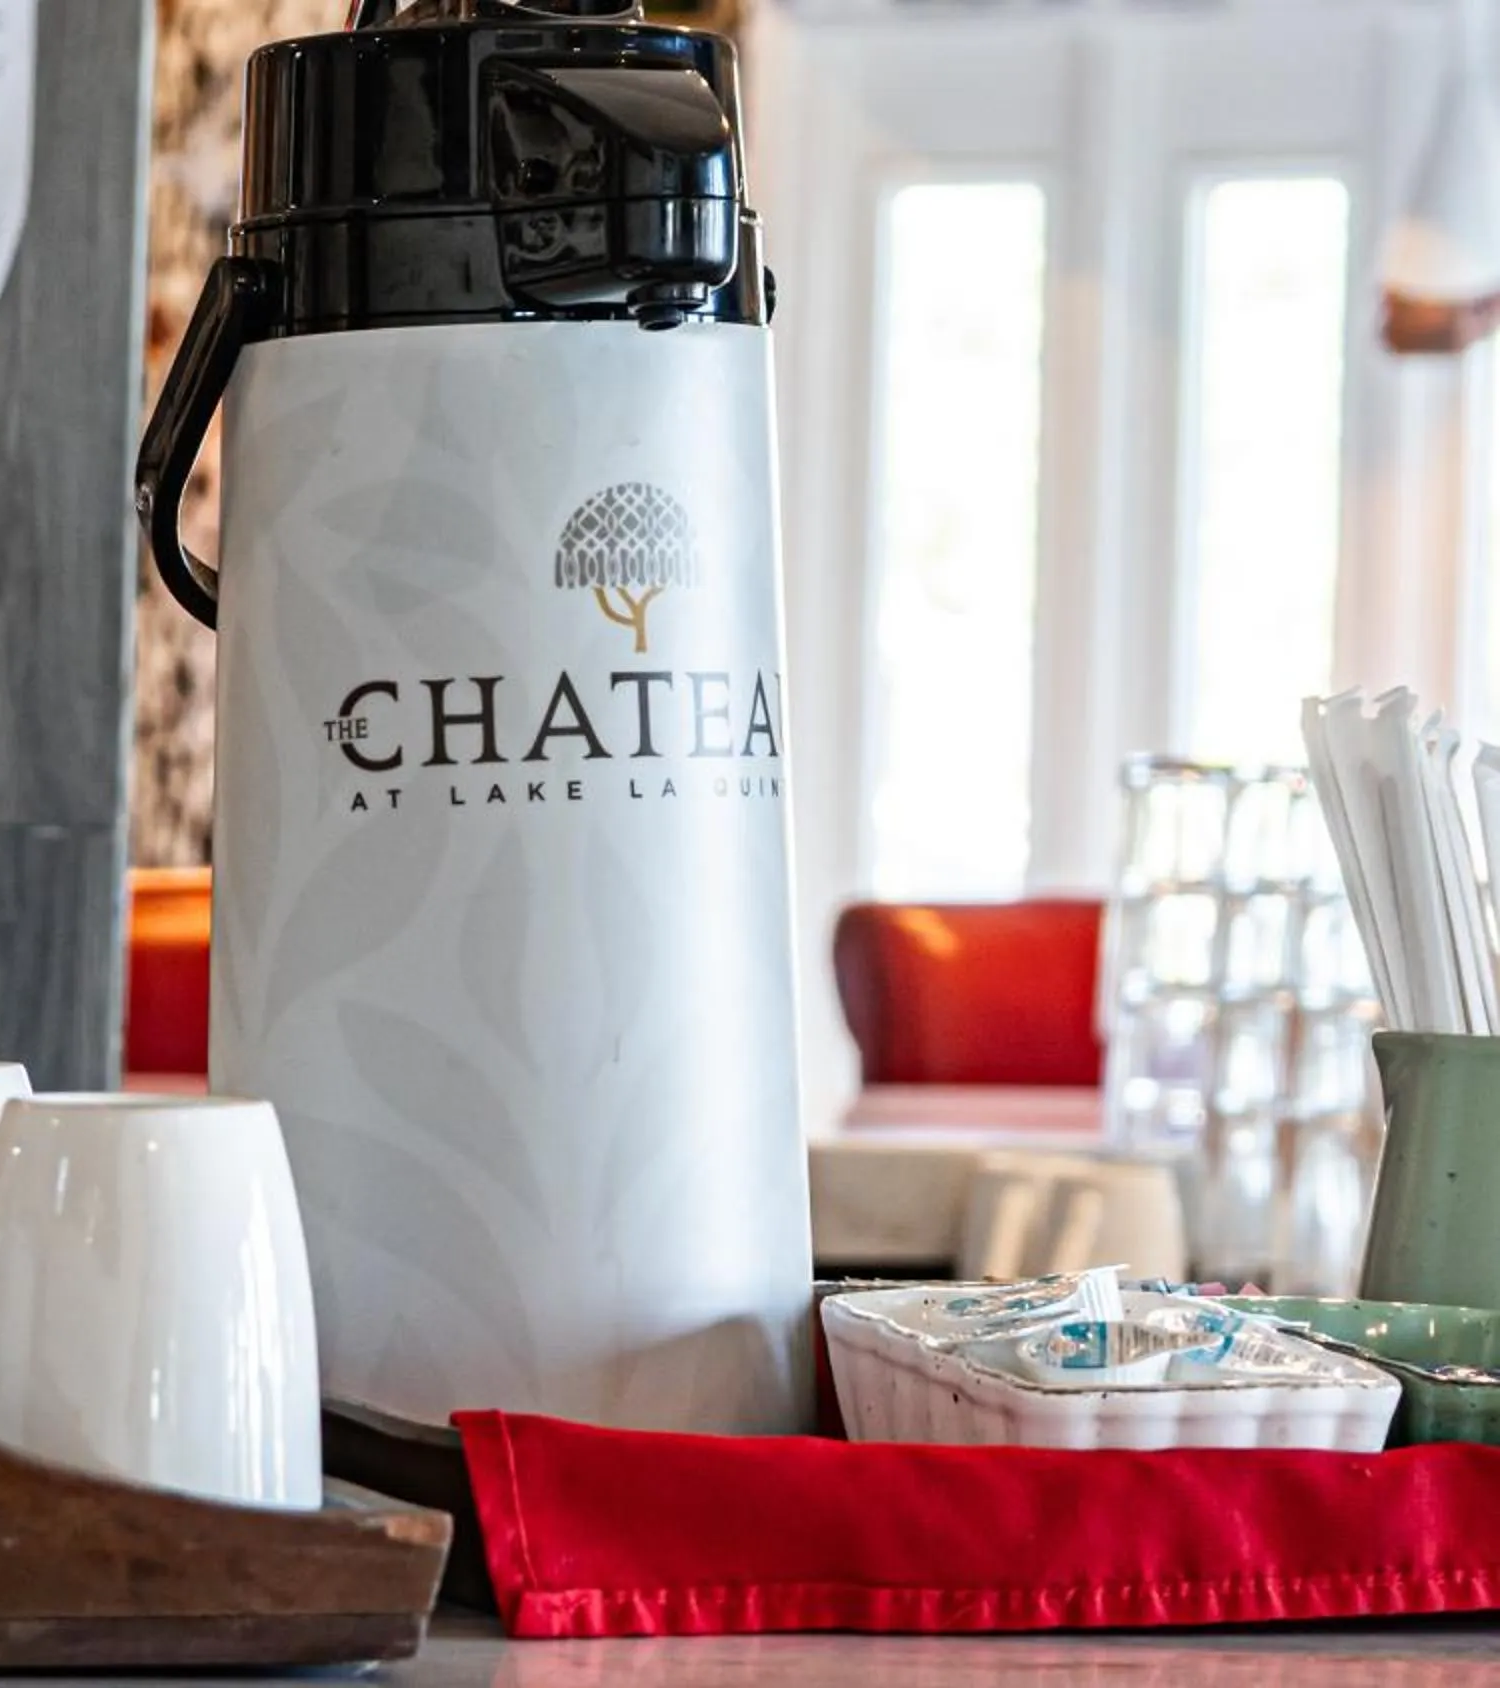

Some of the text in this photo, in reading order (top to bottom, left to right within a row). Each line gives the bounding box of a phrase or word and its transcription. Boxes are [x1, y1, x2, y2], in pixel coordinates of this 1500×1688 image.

[322, 668, 784, 773] THE CHATEA
[351, 776, 782, 812] AT LAKE LA QUIN
